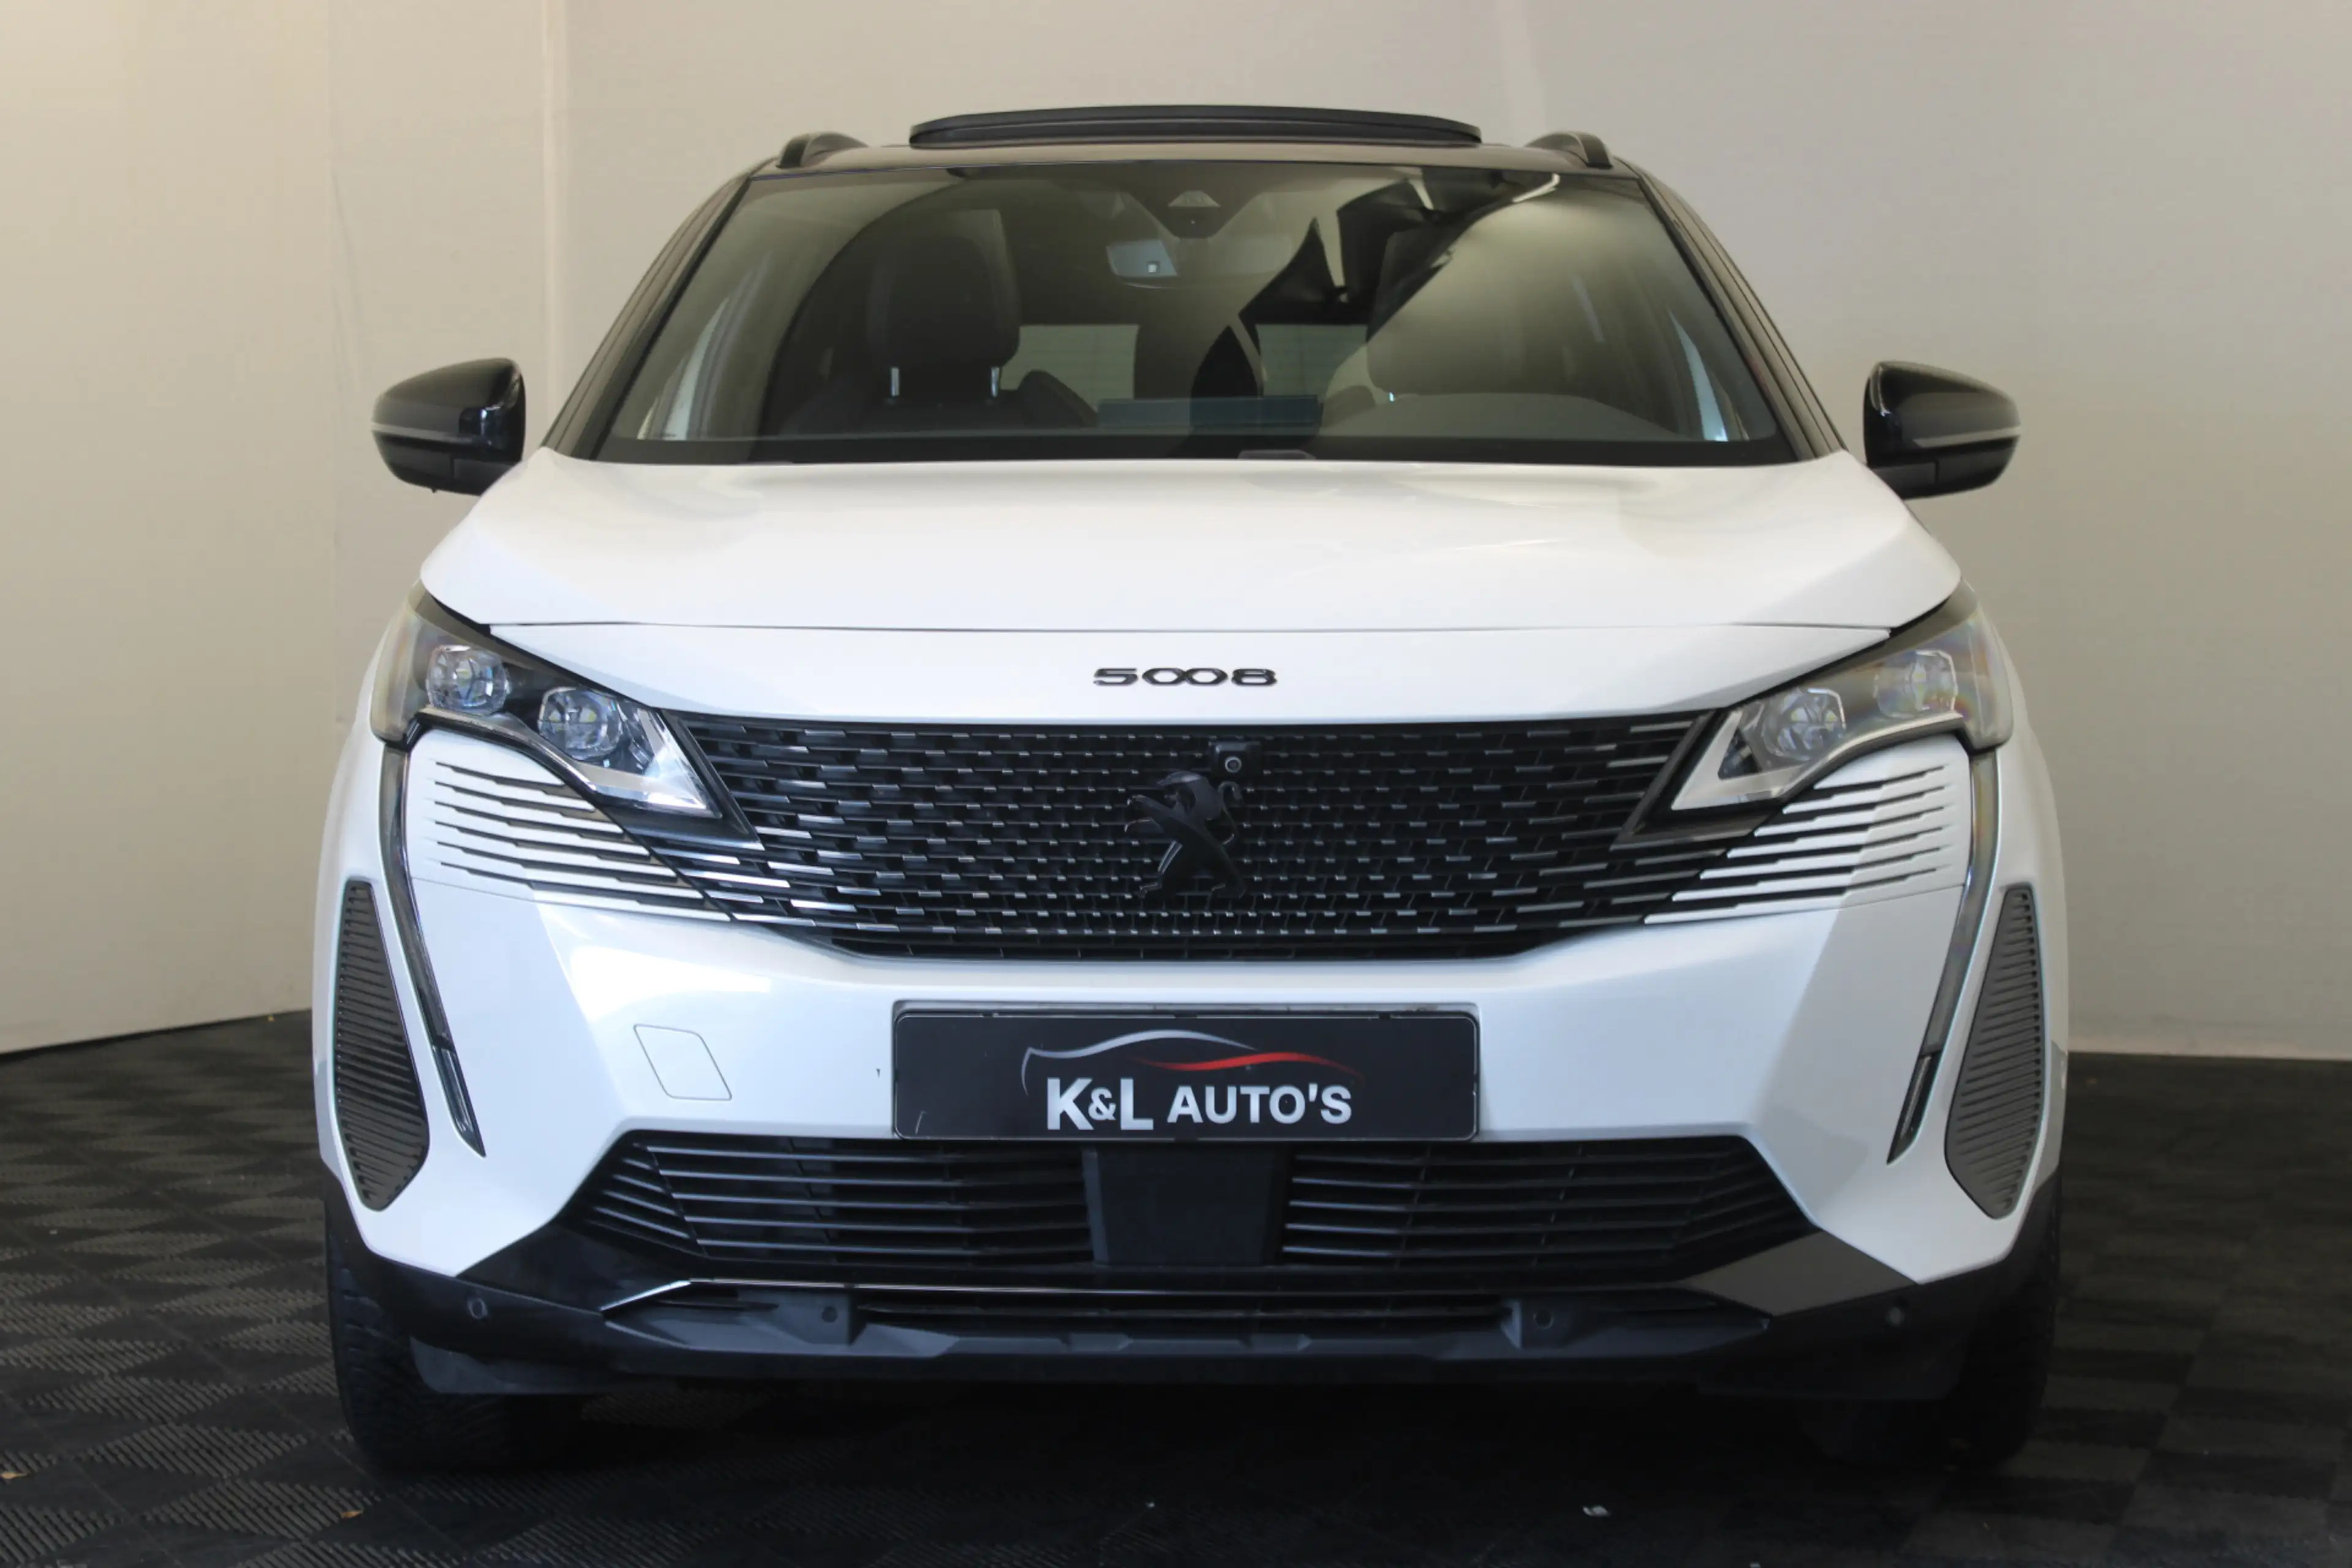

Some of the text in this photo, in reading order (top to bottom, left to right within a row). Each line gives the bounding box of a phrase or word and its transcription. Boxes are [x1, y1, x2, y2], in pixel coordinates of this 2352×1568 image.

[1093, 668, 1278, 687] 5008
[1046, 1077, 1352, 1131] K&L AUTO'S
